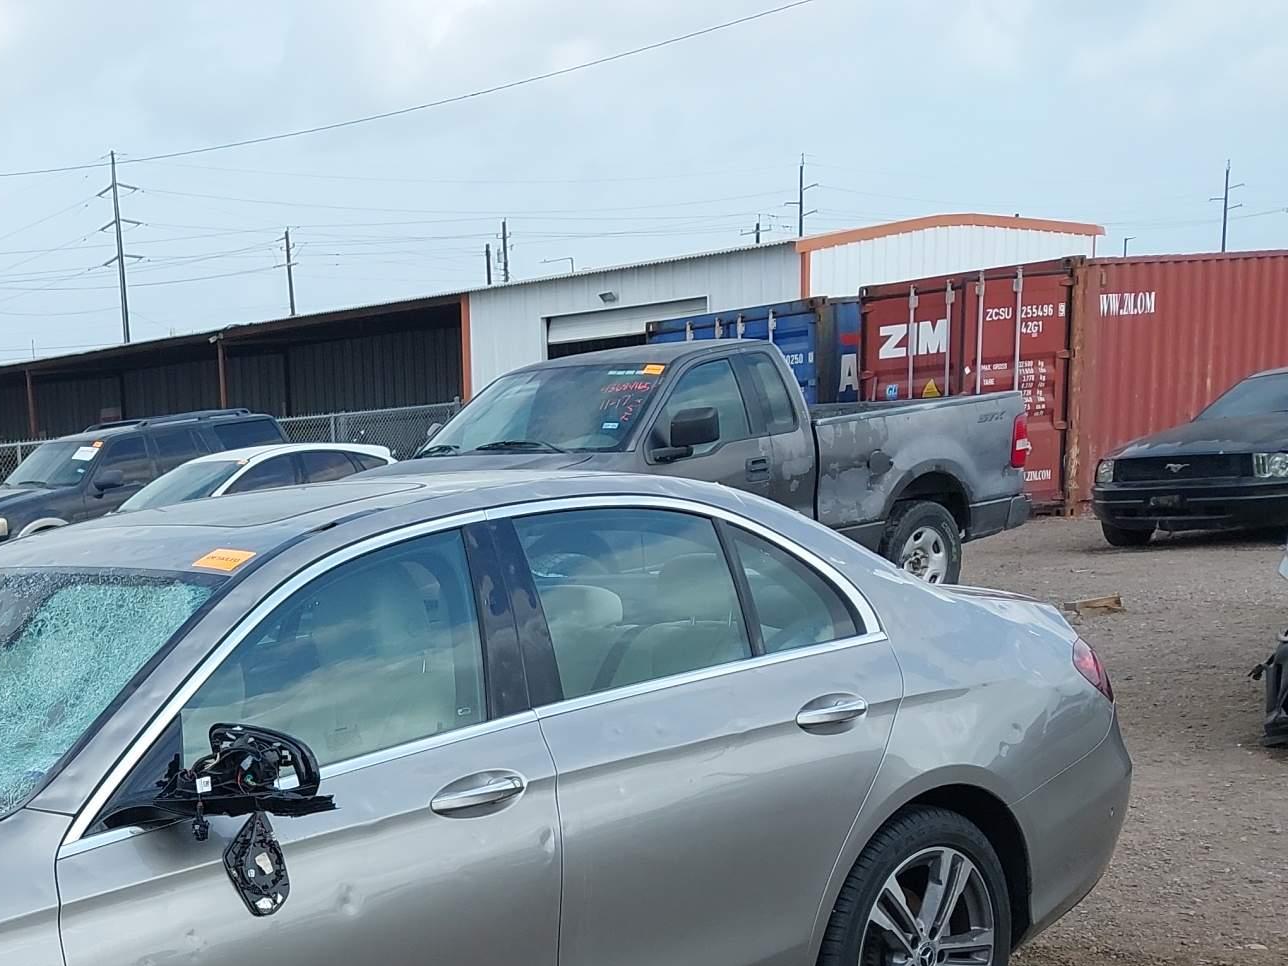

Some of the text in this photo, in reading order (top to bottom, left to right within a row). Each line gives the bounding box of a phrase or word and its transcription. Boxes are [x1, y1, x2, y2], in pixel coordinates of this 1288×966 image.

[985, 307, 1012, 321] ZCSU
[1021, 304, 1054, 318] 255496
[1021, 321, 1043, 334] 42G1
[878, 319, 948, 360] ZIM
[786, 353, 803, 365] 0250
